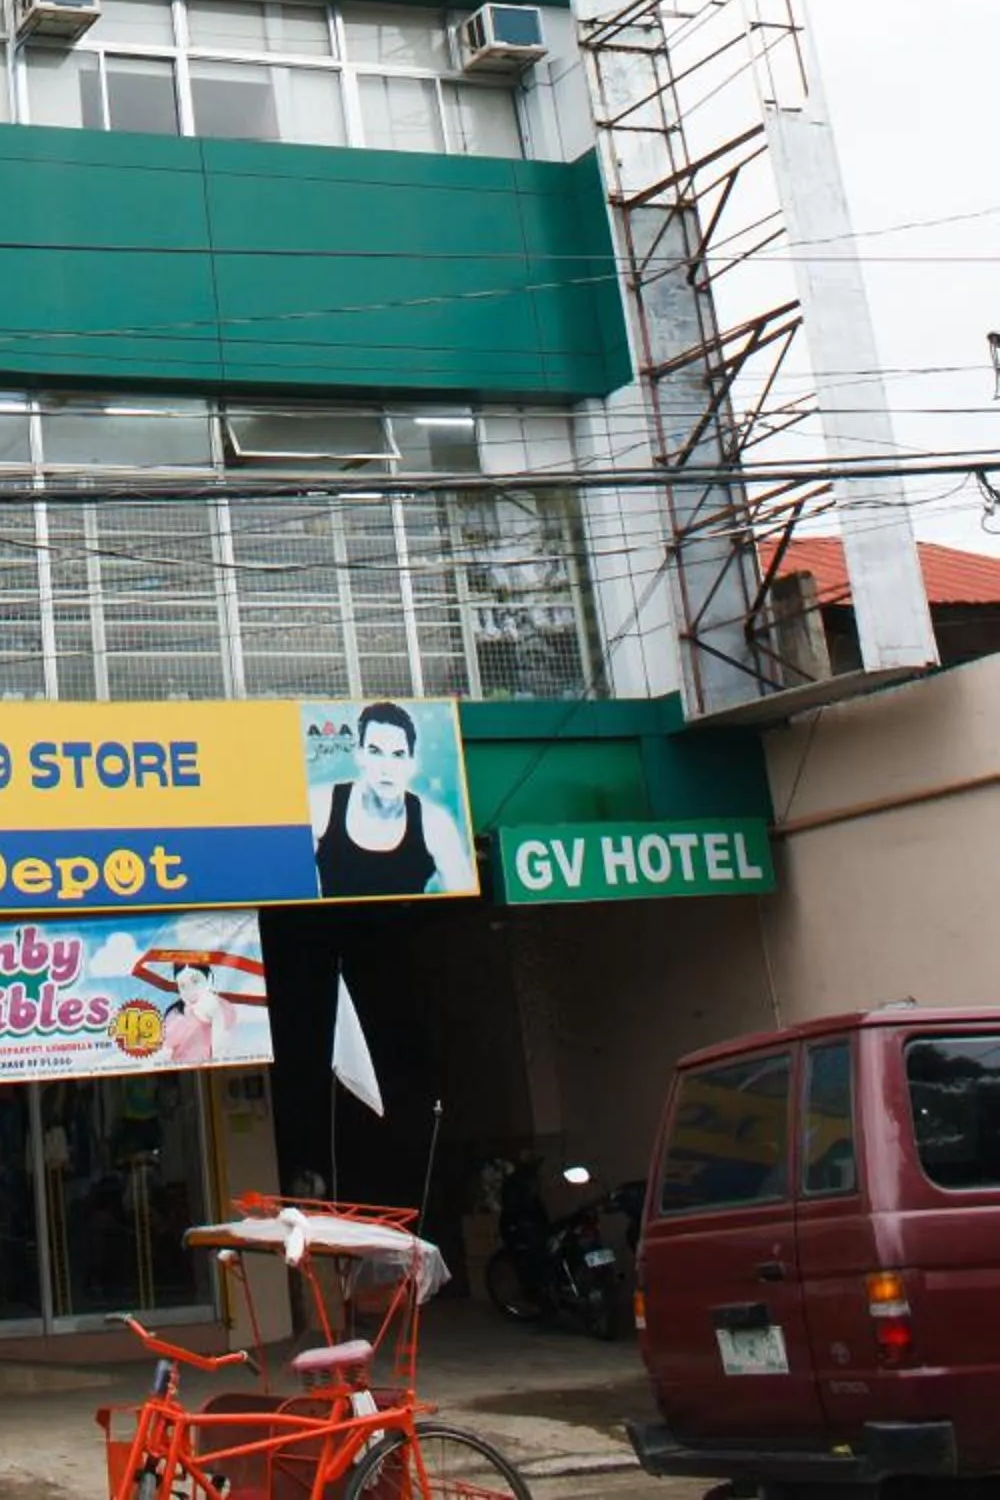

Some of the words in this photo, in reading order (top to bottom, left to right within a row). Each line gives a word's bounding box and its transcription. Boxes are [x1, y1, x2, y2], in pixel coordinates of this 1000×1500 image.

[29, 741, 201, 789] STORE
[515, 838, 584, 890] GV
[600, 832, 763, 885] HOTEL
